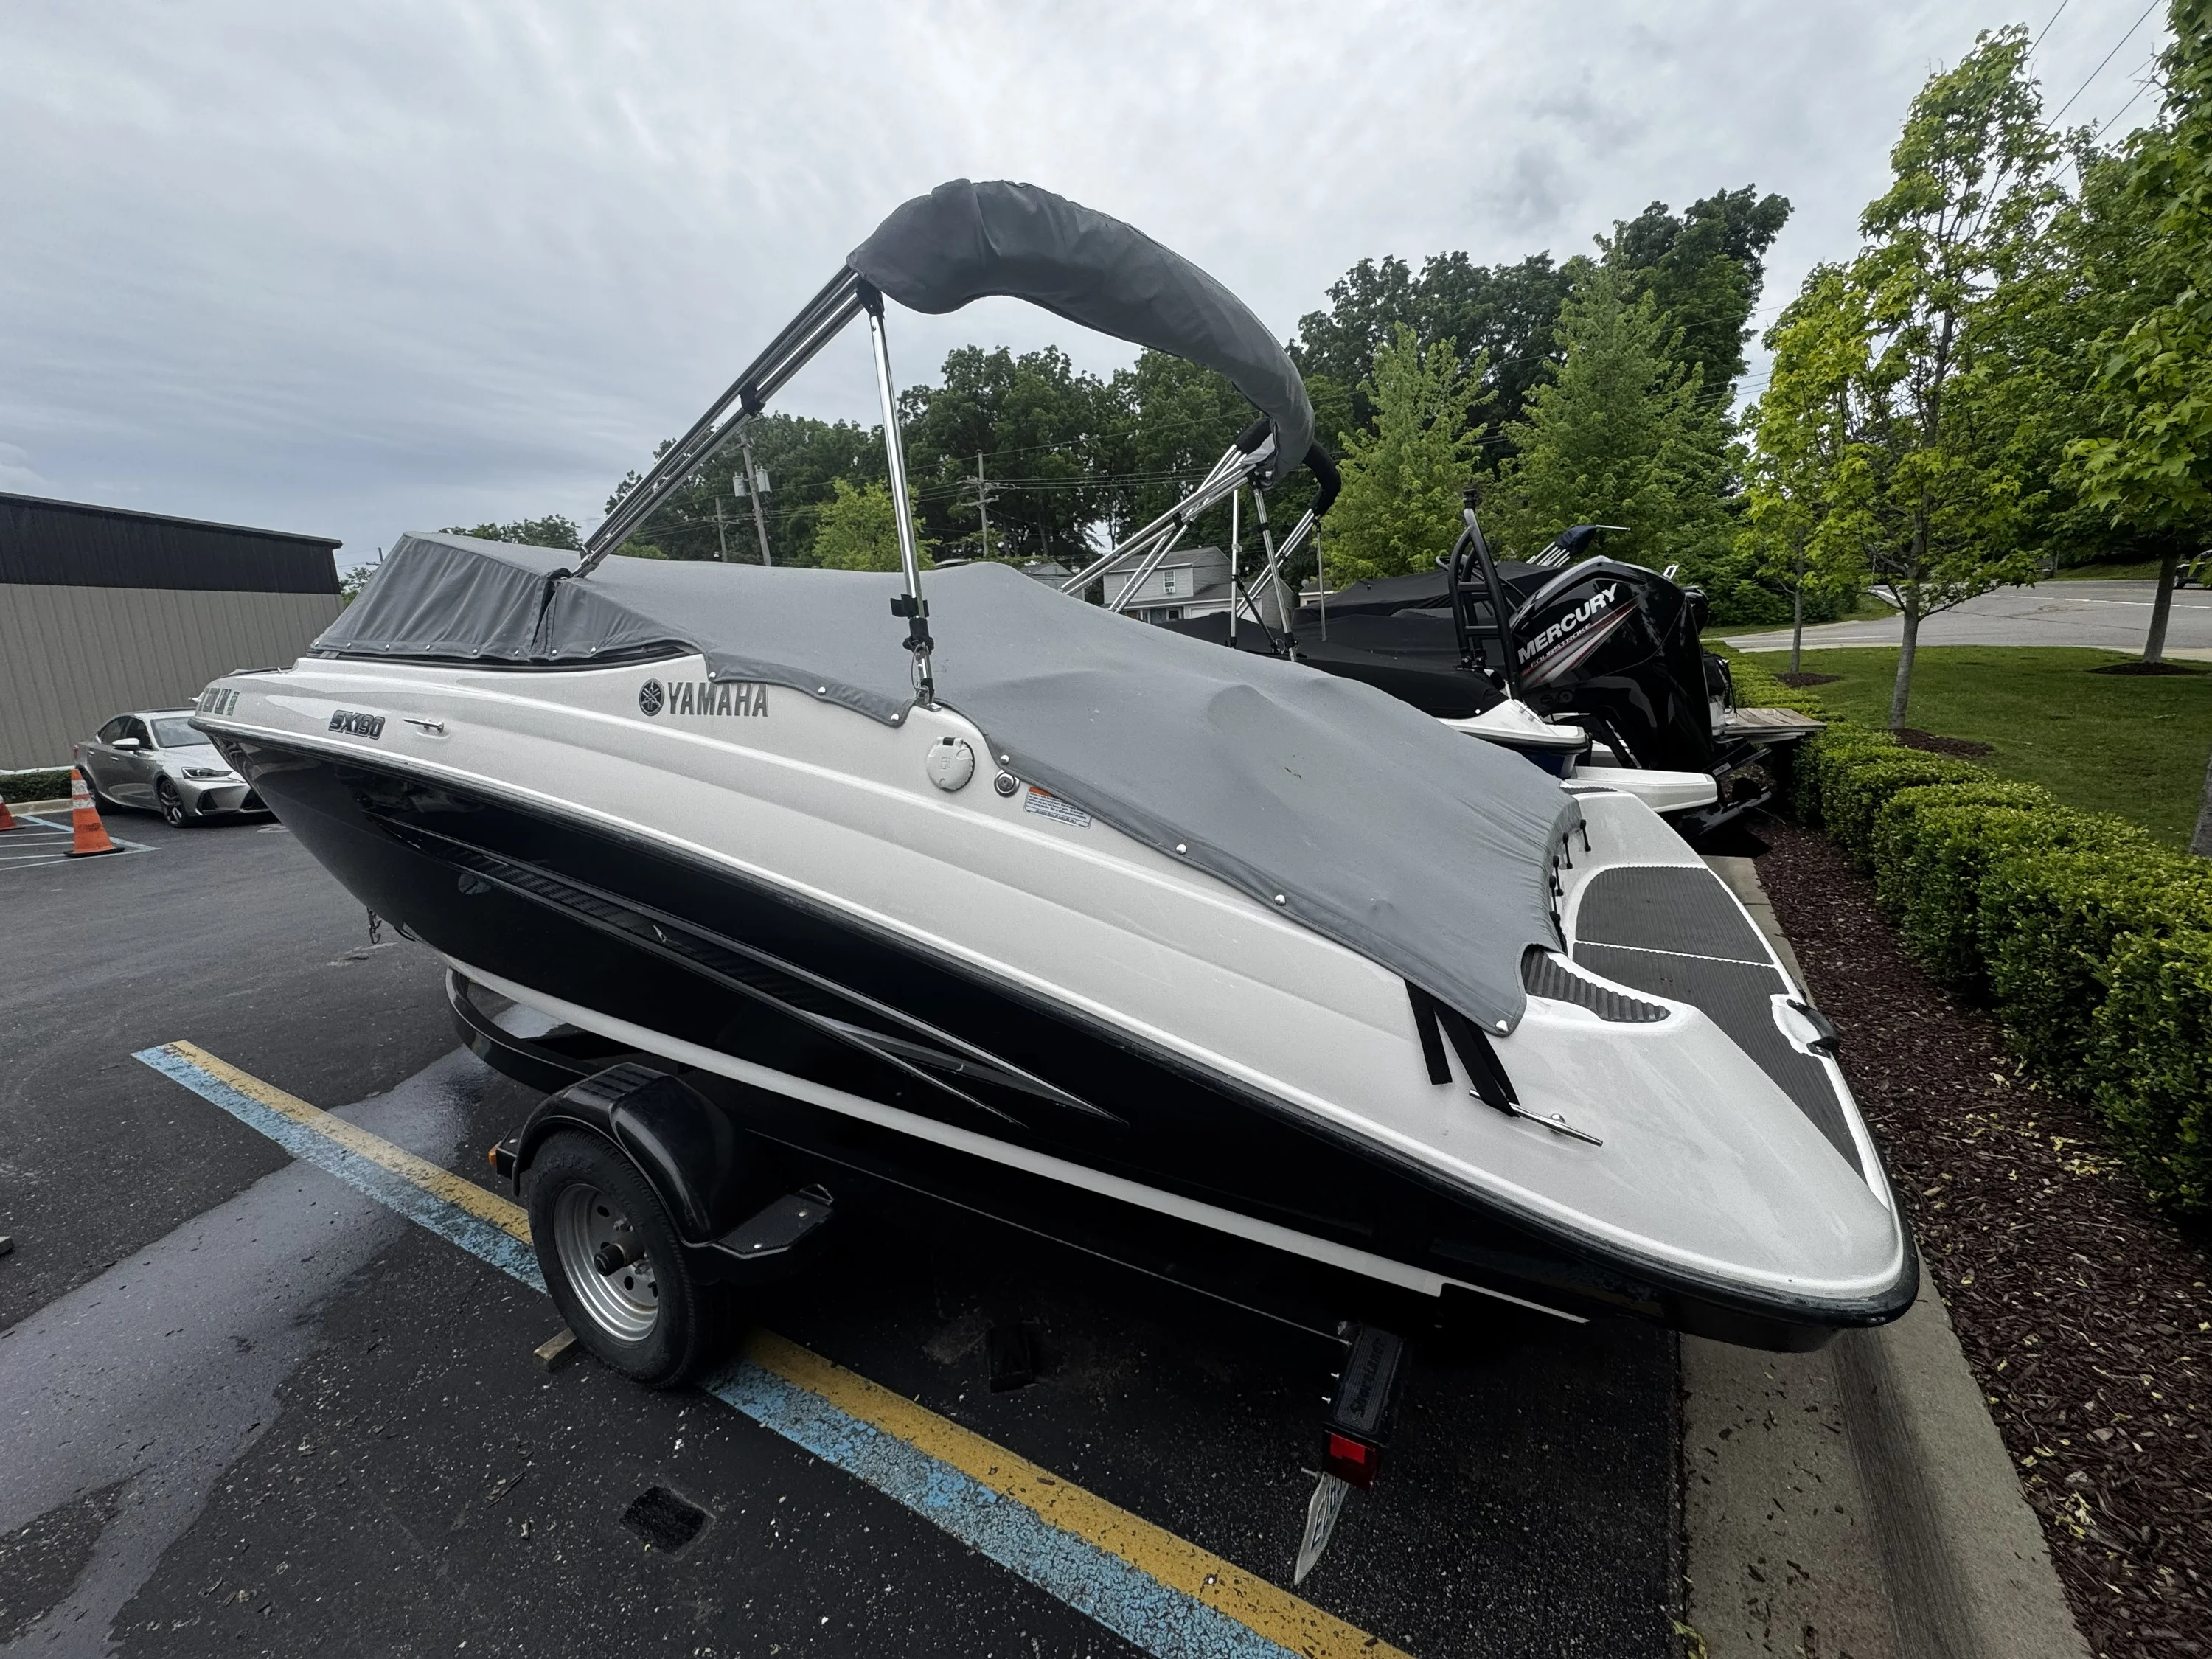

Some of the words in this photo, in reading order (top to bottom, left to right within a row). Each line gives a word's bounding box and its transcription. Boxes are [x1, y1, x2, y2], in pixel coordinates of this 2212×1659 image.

[1517, 582, 1617, 664] MERCURY
[1529, 623, 1591, 668] FOURSTROKE
[667, 682, 769, 717] YAMAHA
[329, 709, 386, 740] SX190
